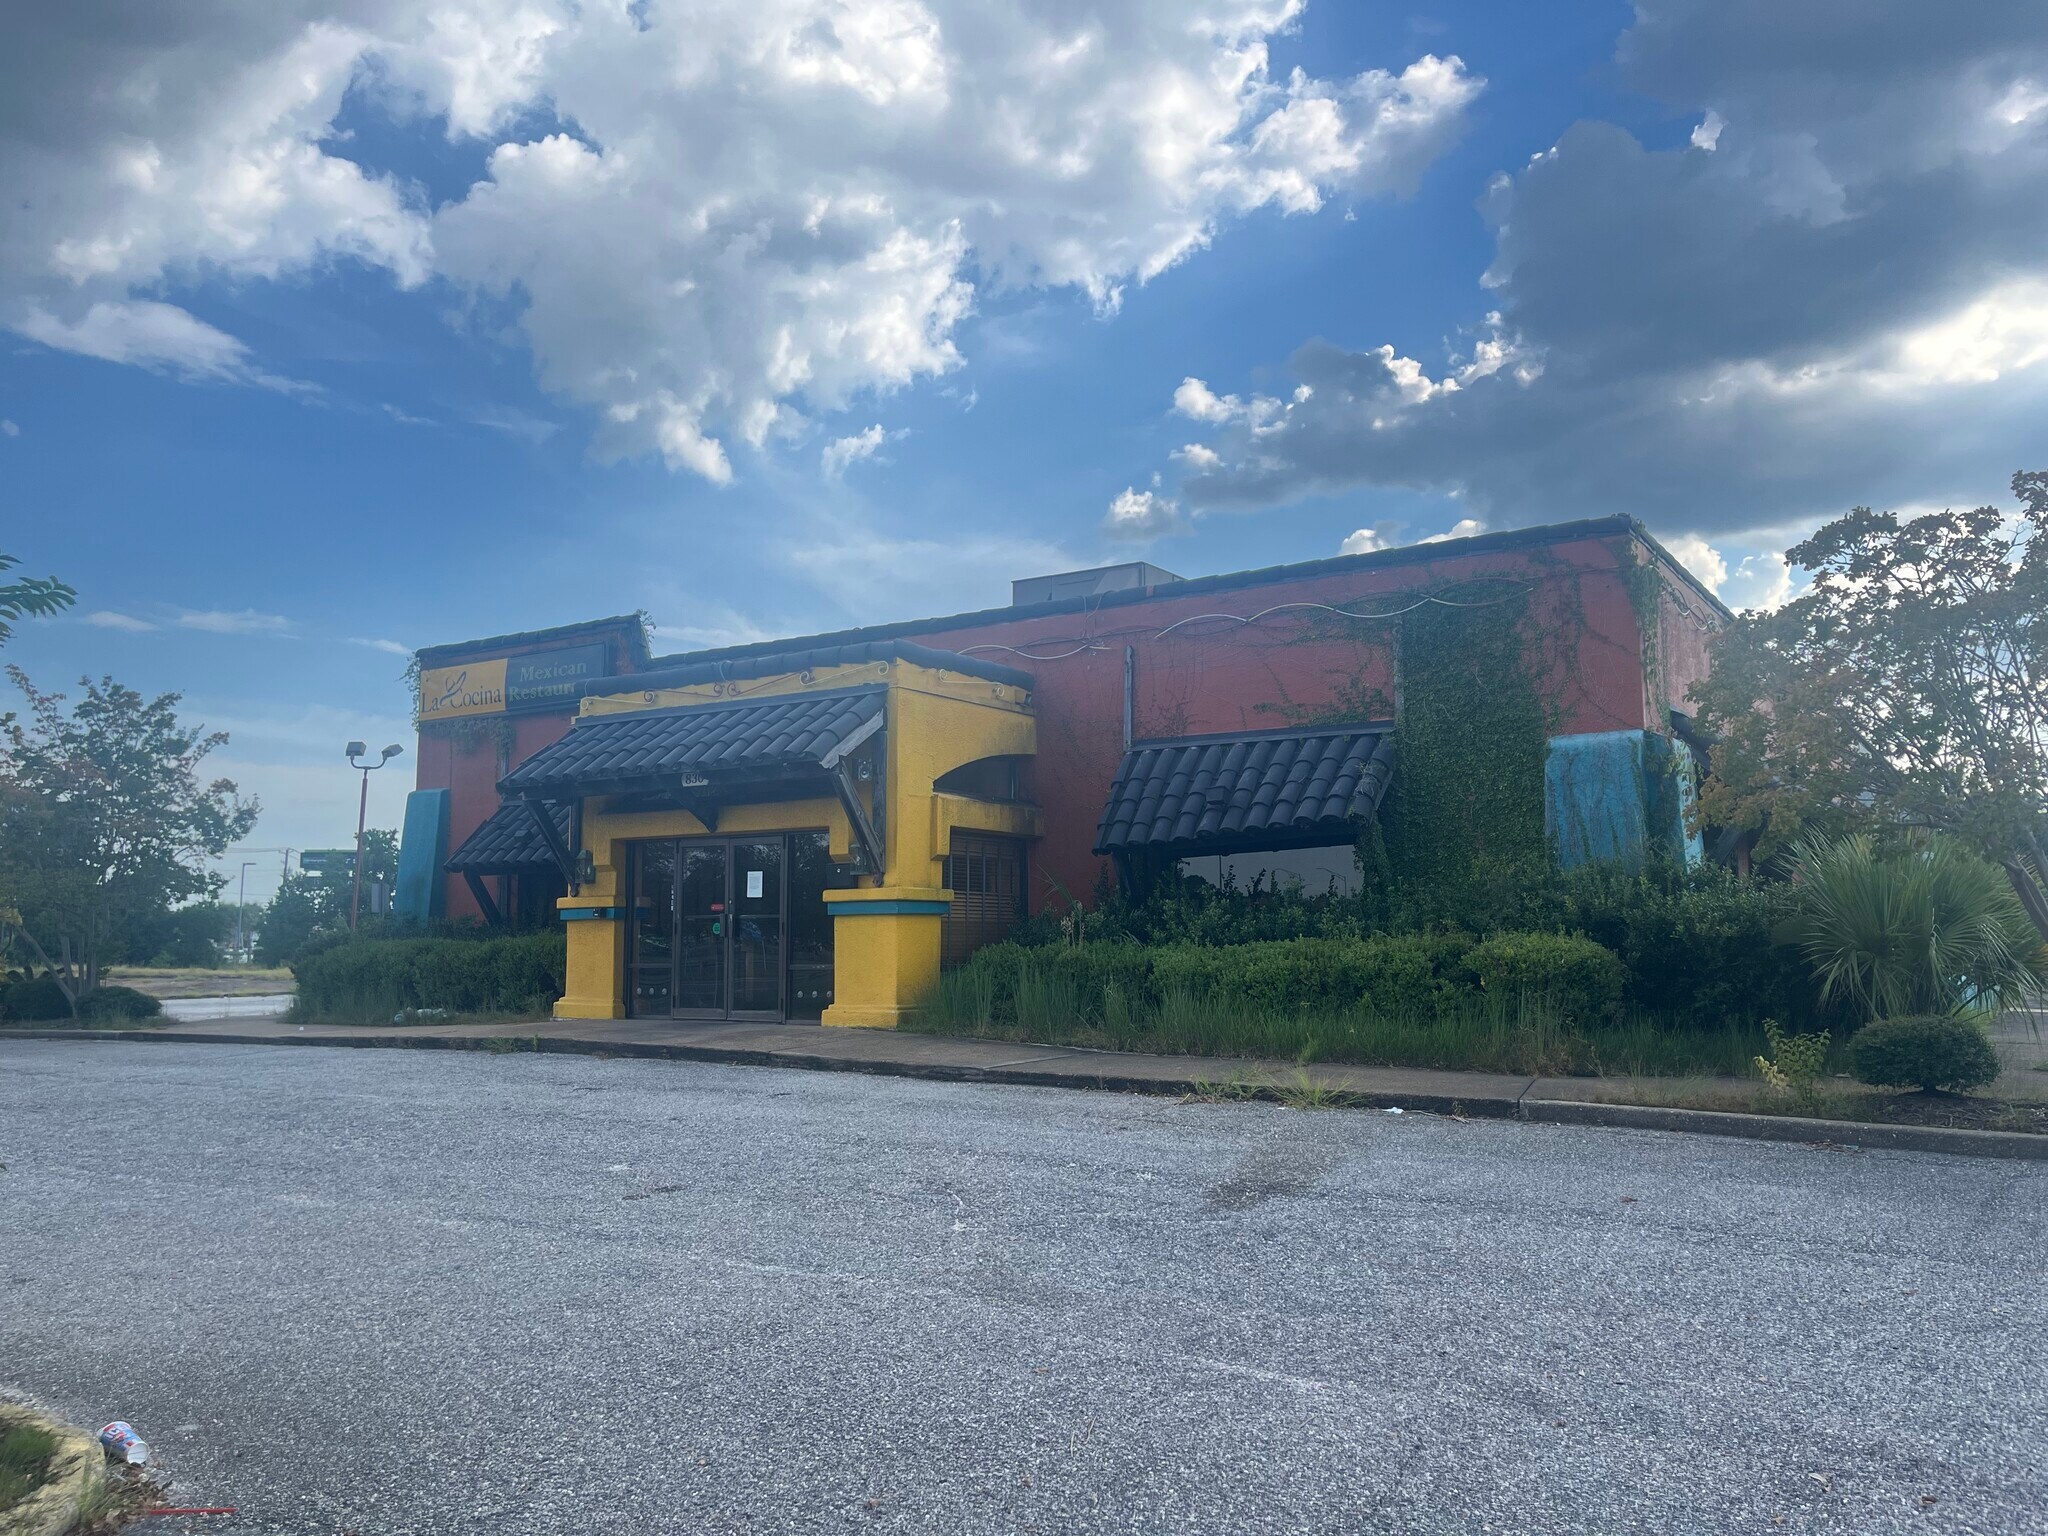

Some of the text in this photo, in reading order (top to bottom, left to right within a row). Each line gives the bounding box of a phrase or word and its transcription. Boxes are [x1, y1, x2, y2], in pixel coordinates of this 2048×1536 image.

[519, 661, 587, 682] Mexican
[421, 685, 502, 713] La Cocina
